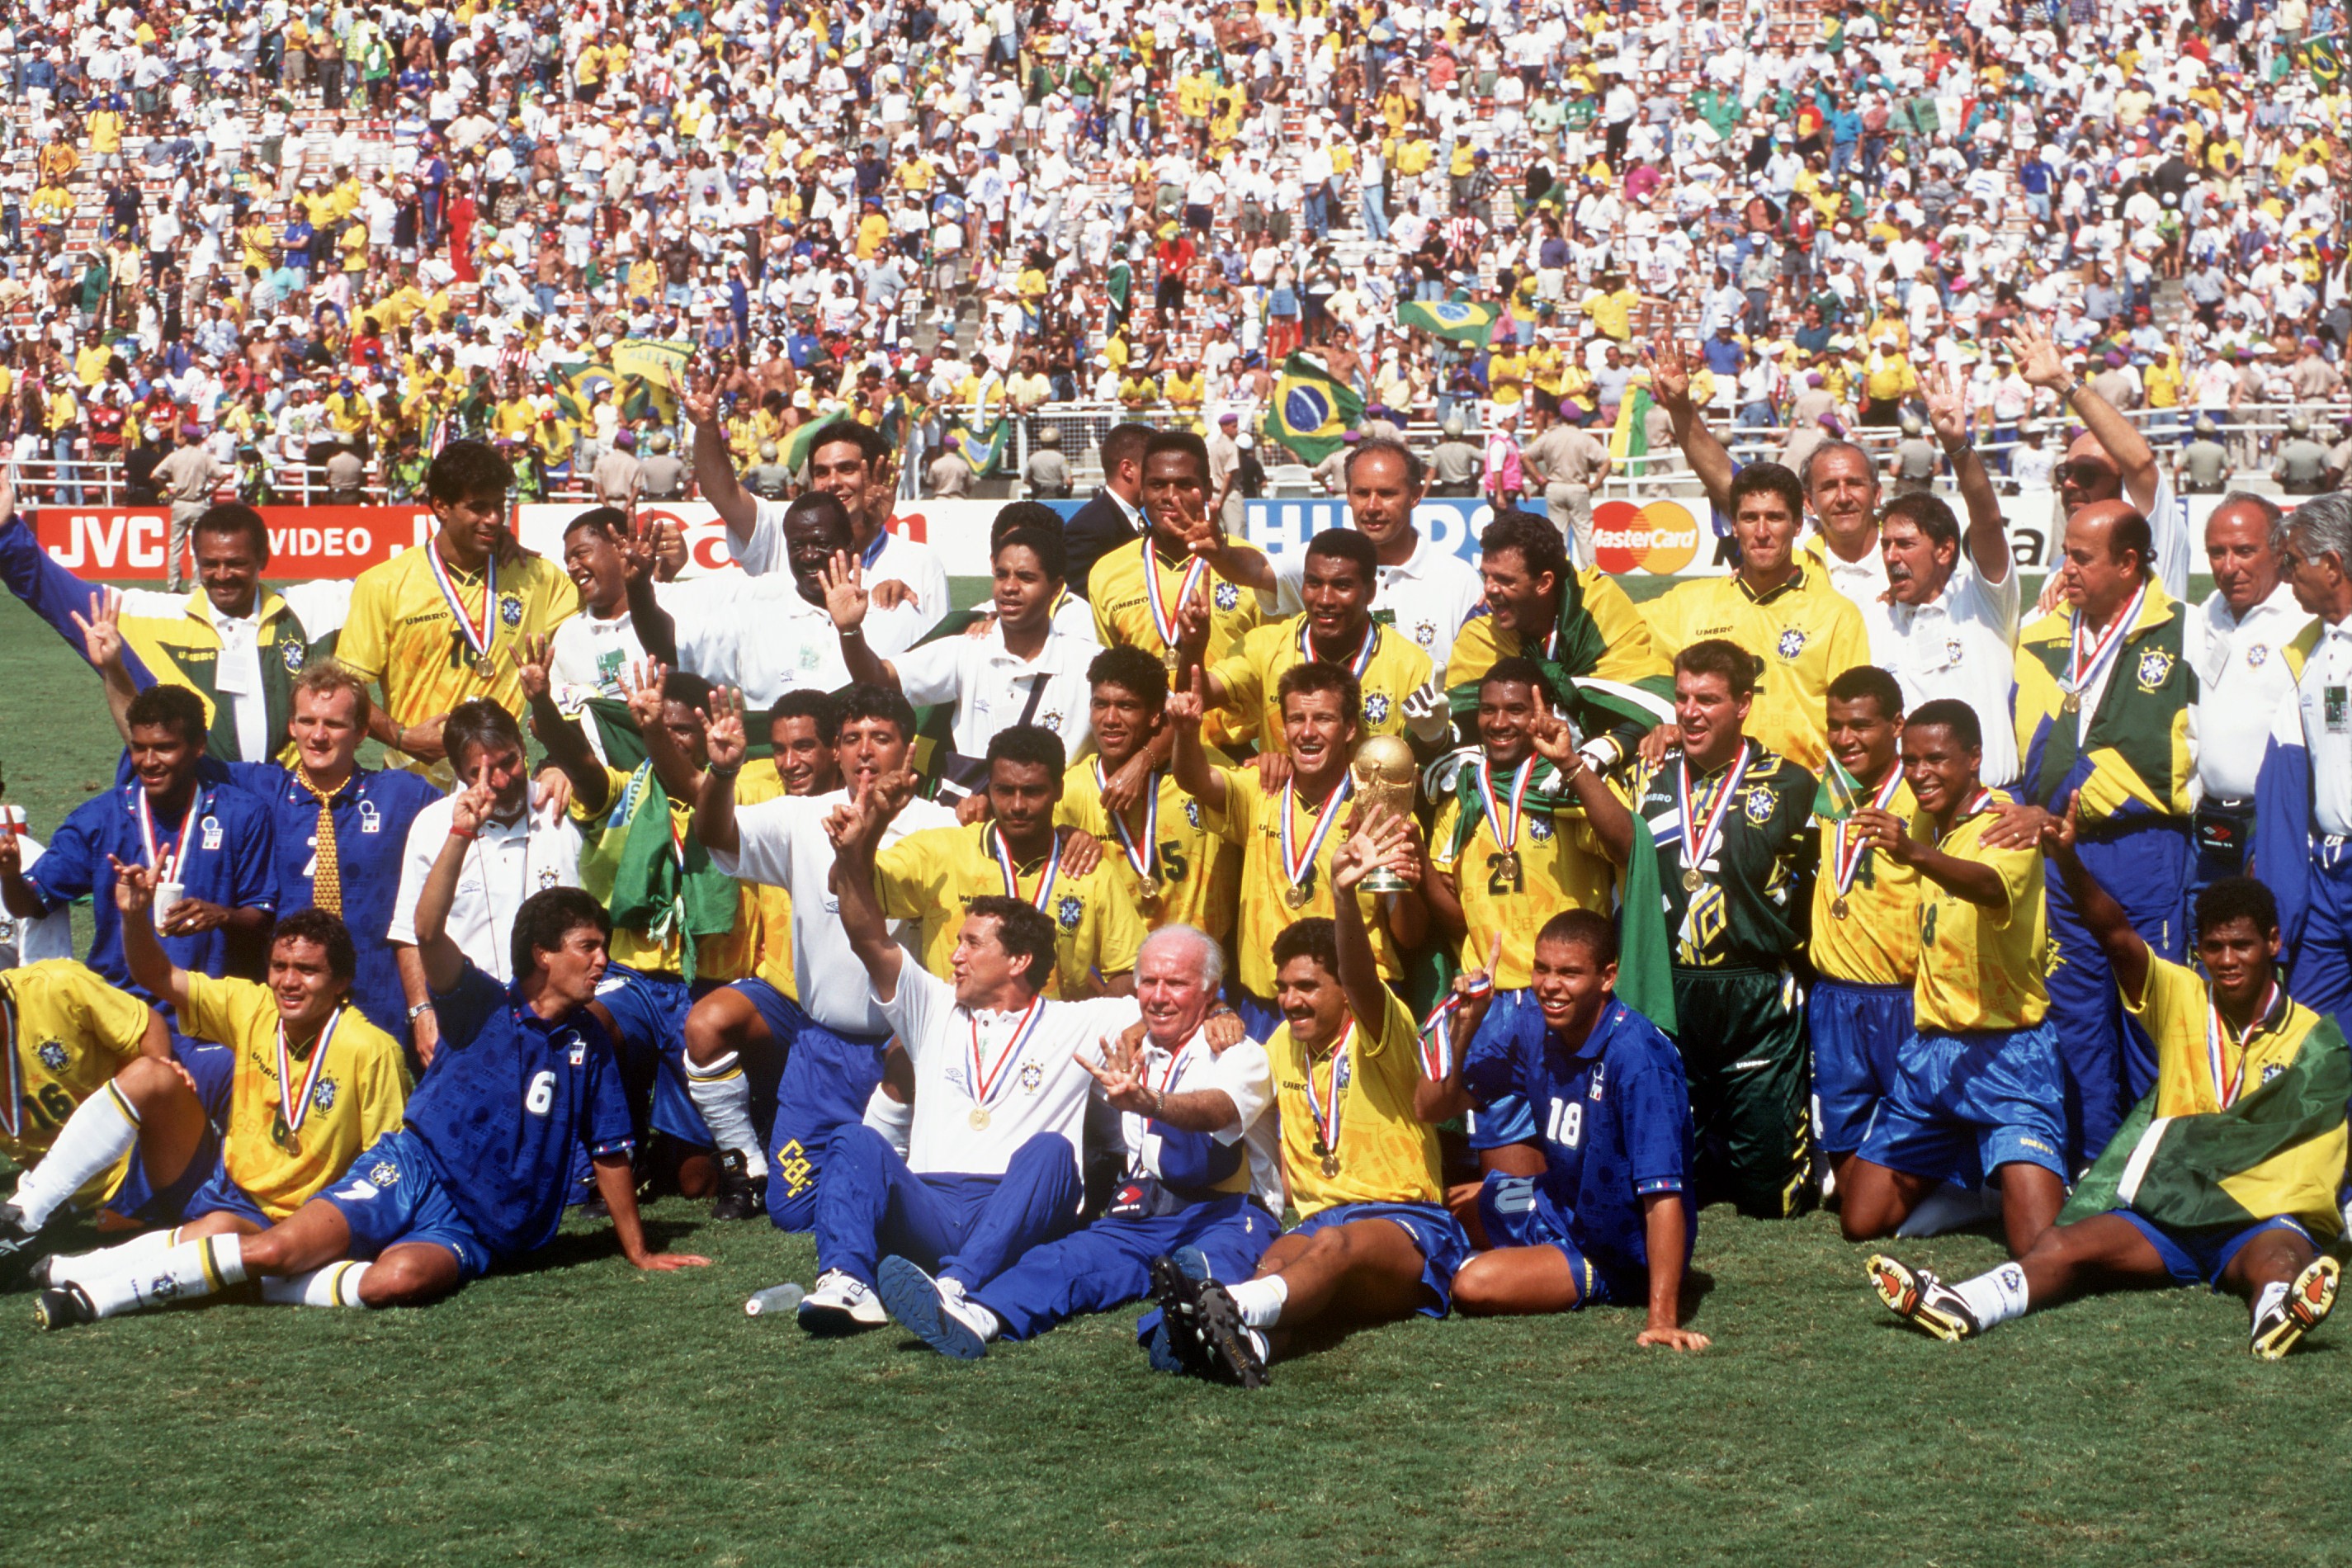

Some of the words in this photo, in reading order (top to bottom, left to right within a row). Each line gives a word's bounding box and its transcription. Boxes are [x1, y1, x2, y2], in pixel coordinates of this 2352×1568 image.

[49, 516, 165, 567] JVC
[266, 526, 372, 557] VIDEO
[1591, 528, 1696, 549] MasterCard
[405, 612, 449, 626] UMBRO
[1112, 596, 1149, 612] UMBRO
[1695, 626, 1734, 636] UMBRO
[1486, 851, 1524, 895] 21
[23, 1083, 73, 1129] 16
[527, 1070, 556, 1116] 6
[1547, 1097, 1582, 1150] 18
